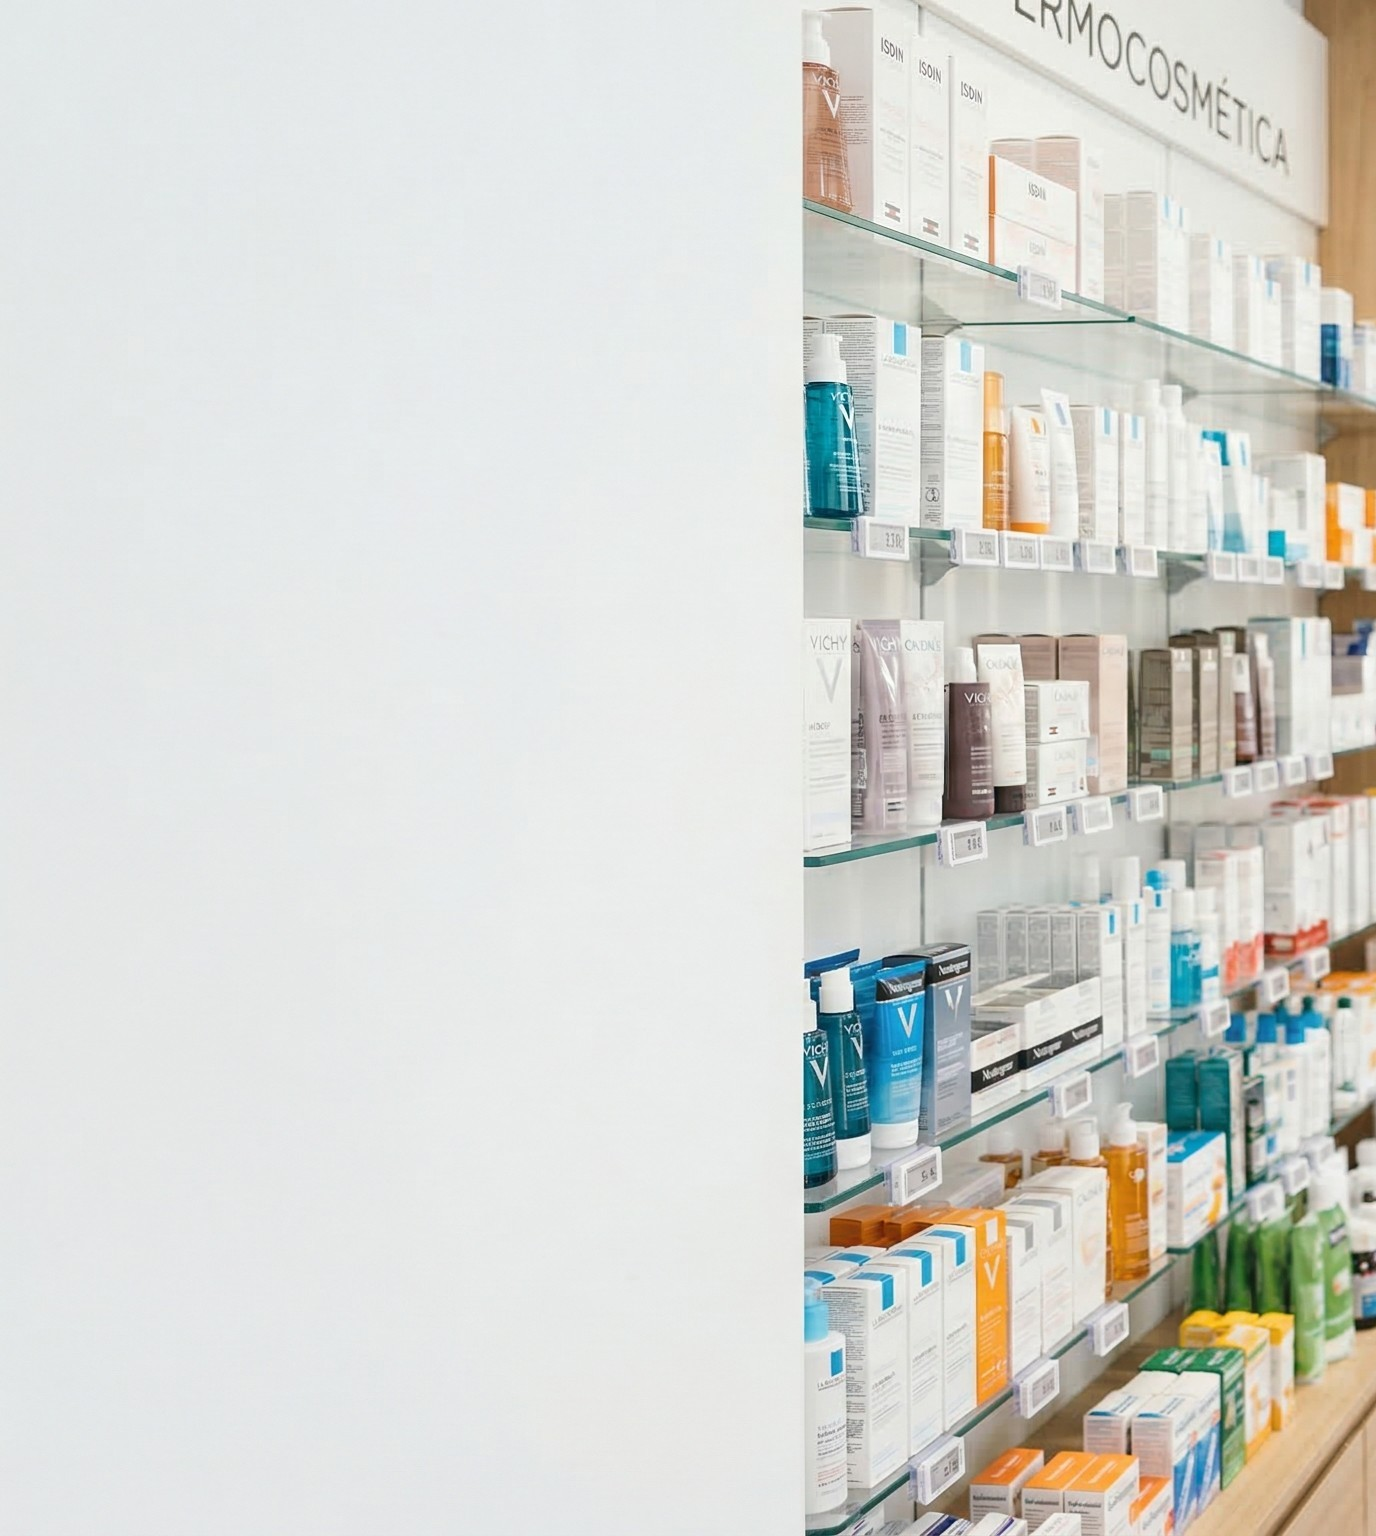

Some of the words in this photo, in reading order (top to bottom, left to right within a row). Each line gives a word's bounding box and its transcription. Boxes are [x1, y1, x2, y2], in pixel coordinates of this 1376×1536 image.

[881, 37, 904, 63] ISDIN
[960, 81, 983, 105] ISDIN
[810, 635, 848, 651] VICHY
[897, 1003, 917, 1039] V
[983, 1254, 1001, 1290] V
